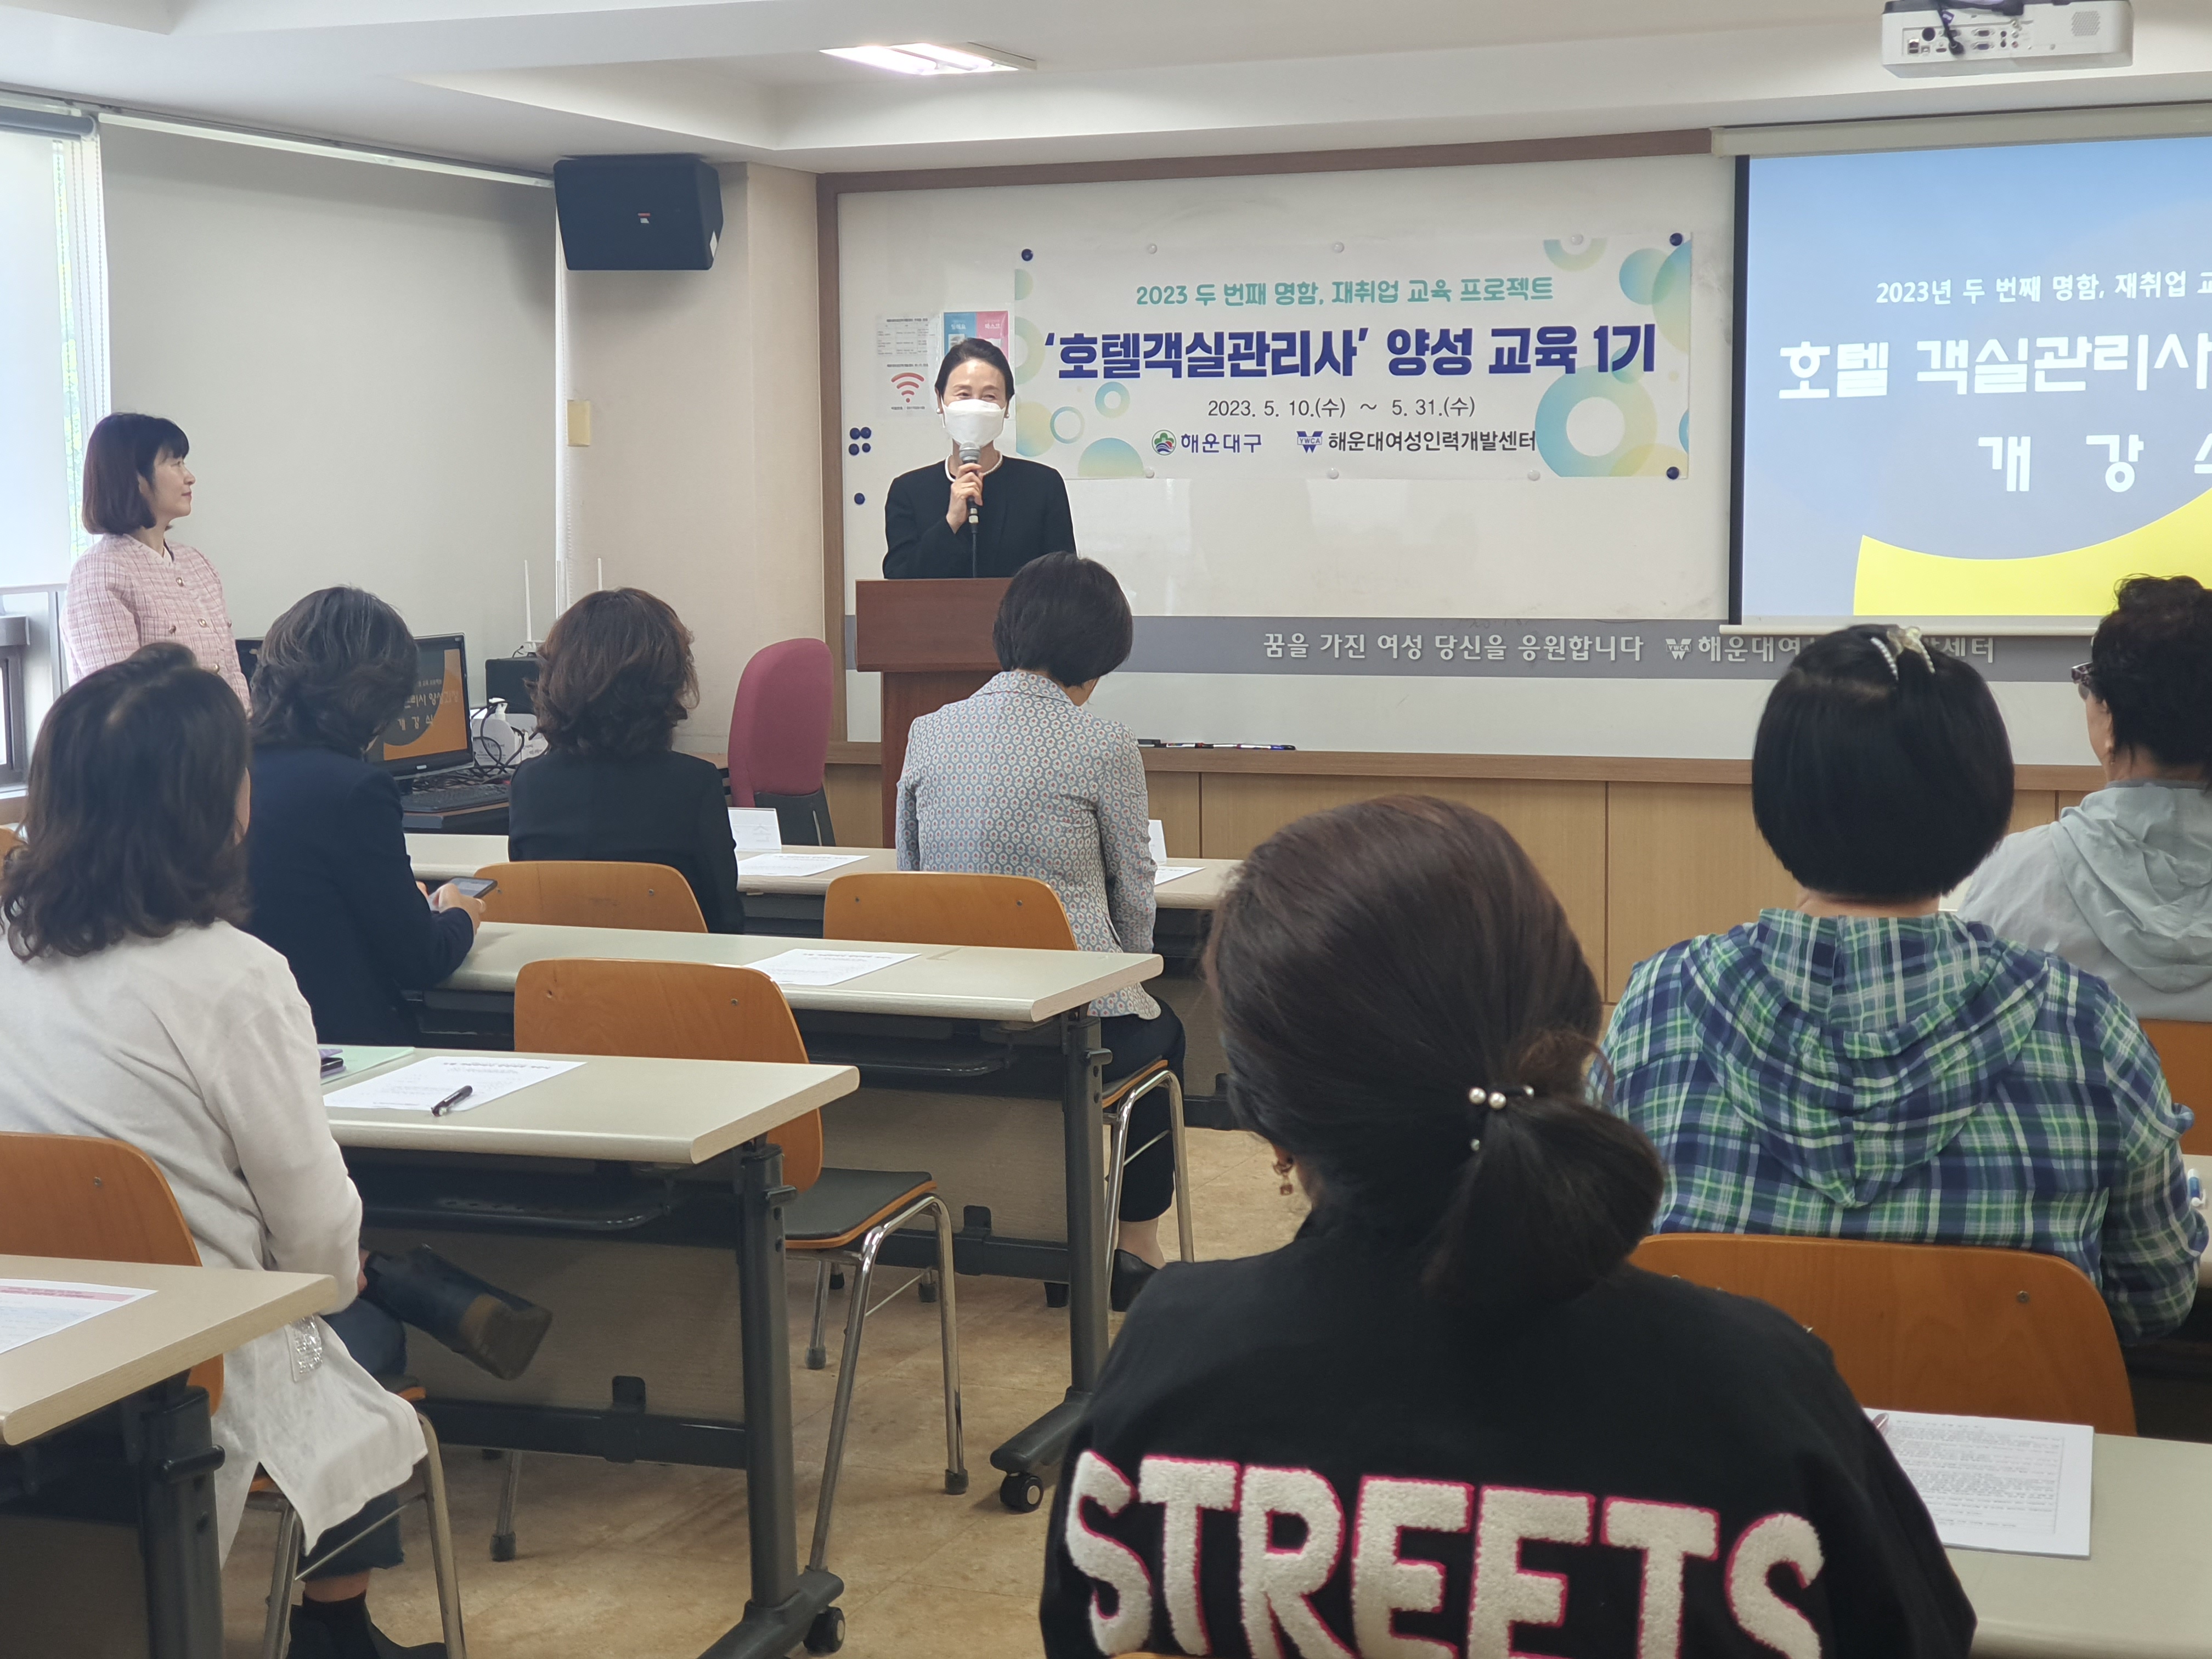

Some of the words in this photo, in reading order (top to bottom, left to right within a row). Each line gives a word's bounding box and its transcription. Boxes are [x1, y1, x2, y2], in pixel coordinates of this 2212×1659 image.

[1137, 285, 1188, 306] 2023
[1195, 284, 1217, 307] 두
[1223, 283, 1267, 307] 번째
[1274, 281, 1324, 306] 명함,
[1331, 280, 1400, 304] 재취업
[1407, 279, 1452, 303] 교육
[1460, 276, 1554, 302] 프로젝트
[1876, 279, 1951, 304] 2023년
[1963, 279, 1985, 304] 두
[1996, 275, 2041, 303] 번째
[2052, 273, 2105, 301] 명함,
[2115, 270, 2186, 299] 재취업
[1386, 328, 1473, 376] 양성
[1488, 326, 1577, 375] 교육
[1593, 324, 1656, 373] 1기
[1779, 341, 1889, 399] 호텔
[1916, 332, 2212, 395] 객실관리사
[1208, 400, 1256, 417] 2023.
[1263, 400, 1279, 417] 5.
[1289, 397, 1345, 418] 10.(수)
[1392, 399, 1408, 416] 5.
[1415, 396, 1475, 417] 31.(수)
[1181, 433, 1262, 453] 해운대구
[1328, 430, 1536, 452] 해운대여성인력개발센터
[1978, 436, 2031, 492] 개
[2086, 435, 2144, 492] 강
[1263, 633, 1310, 658] 꿈을
[1319, 633, 1365, 659] 가진
[1377, 634, 1422, 661] 여성
[1435, 634, 1507, 661] 당신을
[1518, 635, 1644, 661] 응원합니다
[1065, 1450, 1825, 1659] STREETS
